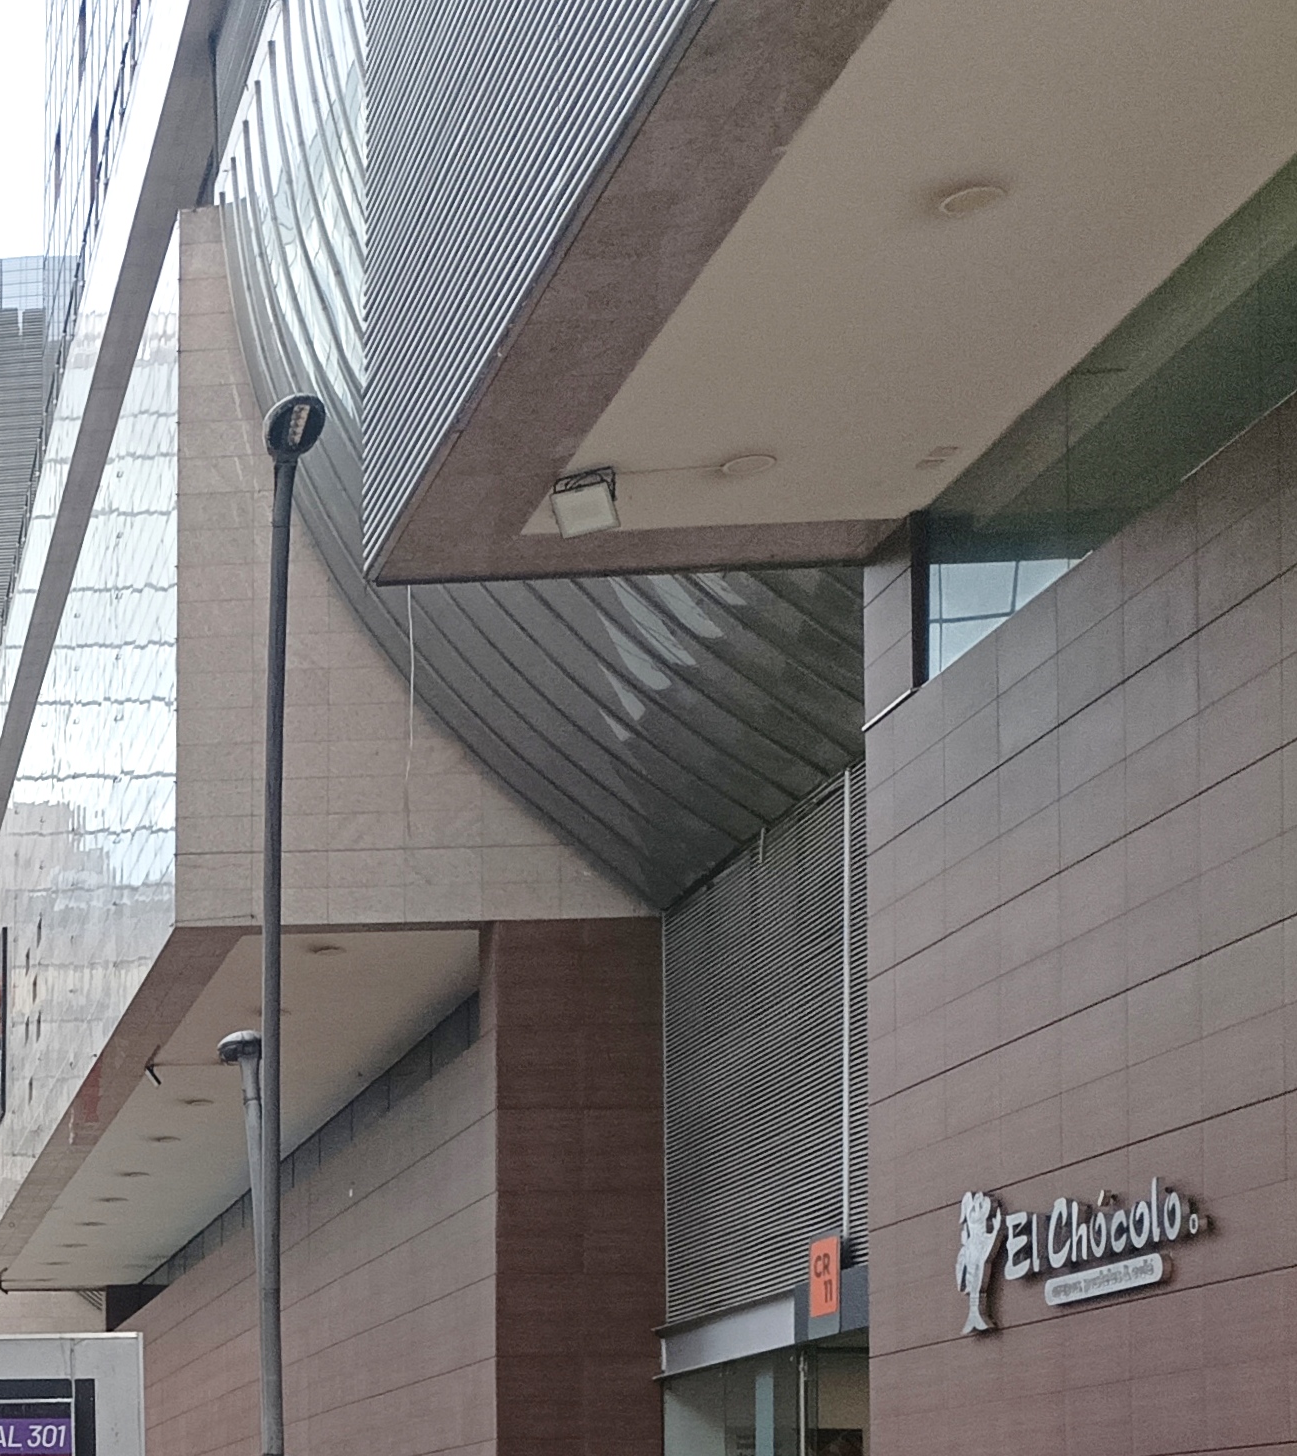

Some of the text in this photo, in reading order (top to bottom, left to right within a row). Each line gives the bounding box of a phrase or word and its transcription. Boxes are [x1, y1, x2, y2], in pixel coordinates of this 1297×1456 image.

[1005, 1212, 1040, 1280] El
[814, 1252, 831, 1278] CR
[823, 1278, 833, 1303] 11
[27, 1425, 67, 1448] 301
